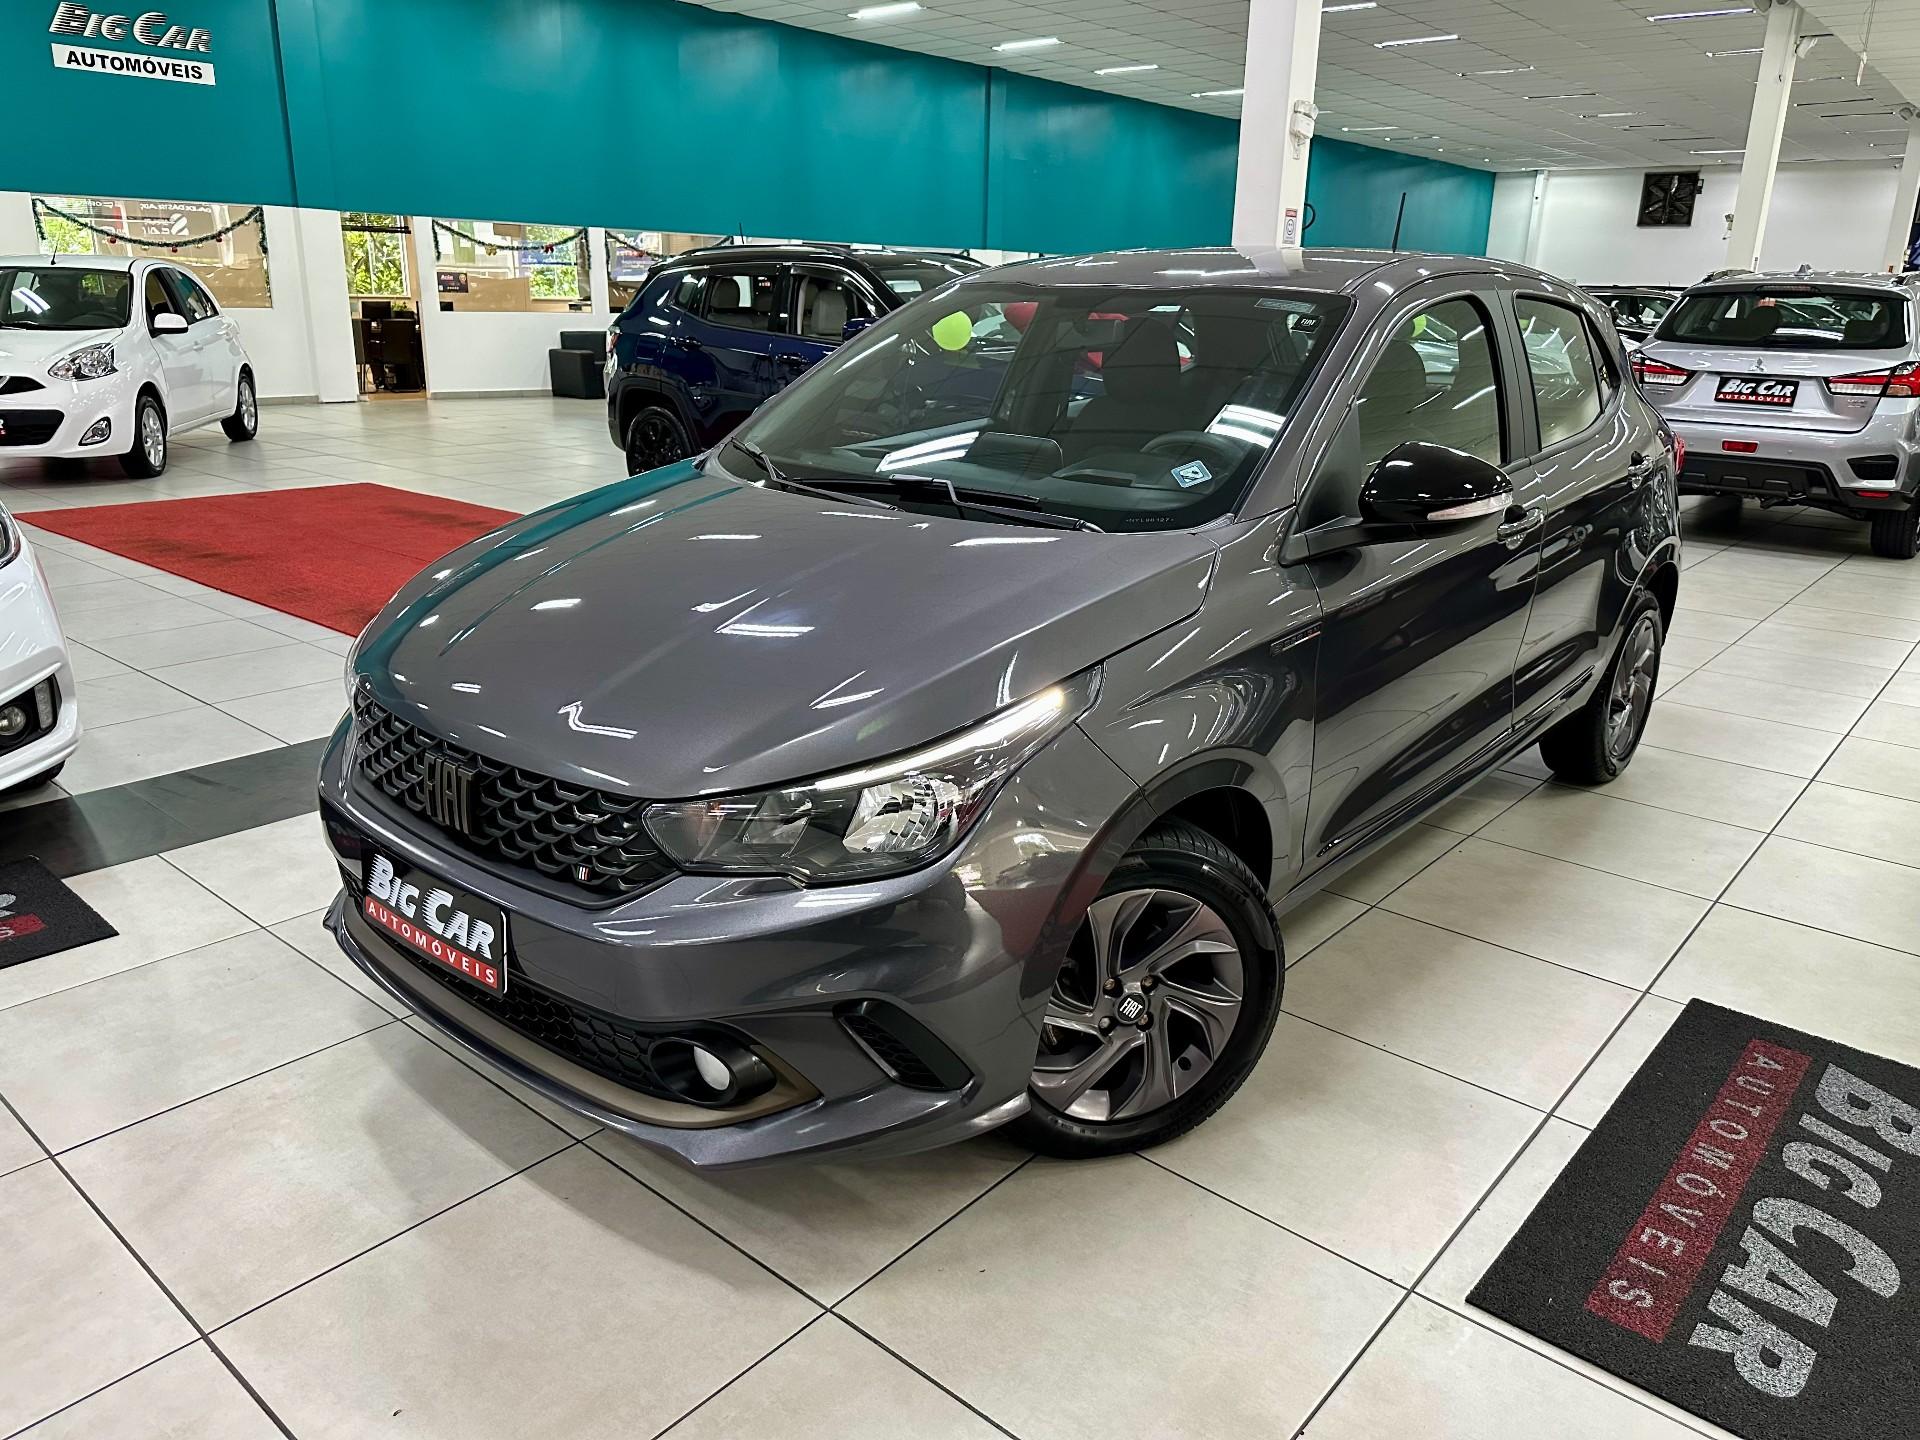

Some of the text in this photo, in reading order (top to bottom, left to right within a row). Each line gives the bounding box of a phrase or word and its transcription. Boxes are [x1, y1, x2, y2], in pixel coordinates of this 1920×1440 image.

[49, 1, 213, 53] BIG CAR
[66, 50, 203, 80] AUTOMÓVEIS
[1300, 318, 1317, 326] FIAT
[1721, 378, 1795, 397] BIG CAR
[424, 752, 477, 835] FIAT
[367, 853, 495, 960] BIG CAR
[368, 901, 495, 985] AUTOMÓVEIS
[1119, 997, 1143, 1019] FIAT
[1608, 1051, 1786, 1309] AUTOMÓVEIS
[1687, 1062, 1920, 1399] BIG CAR
